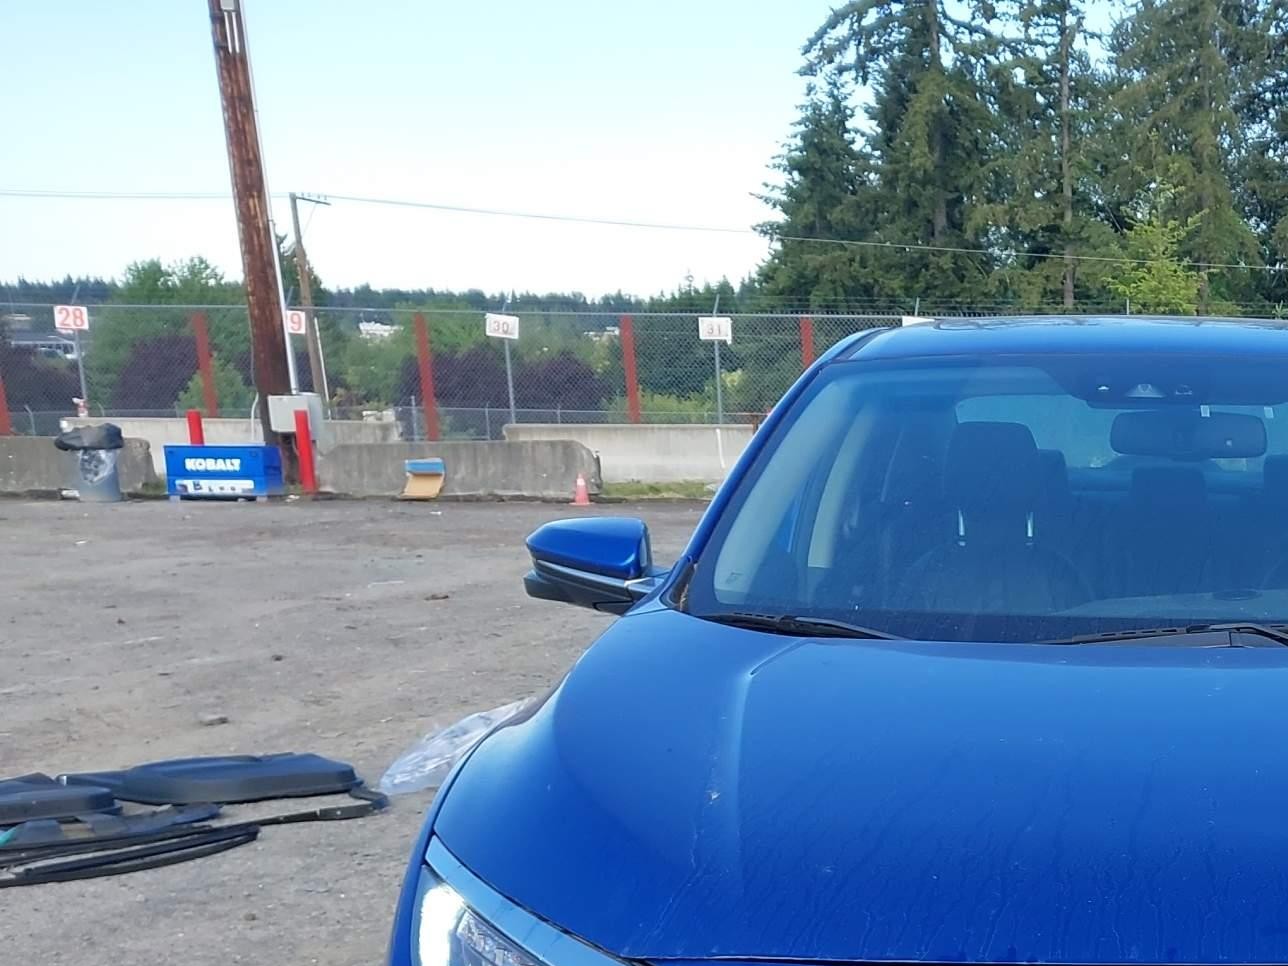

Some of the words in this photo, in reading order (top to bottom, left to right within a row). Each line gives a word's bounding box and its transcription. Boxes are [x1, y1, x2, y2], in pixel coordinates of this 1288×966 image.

[57, 307, 85, 327] 28
[287, 312, 302, 331] 9
[493, 320, 510, 335] 30
[706, 323, 721, 336] 31
[185, 458, 241, 472] KOBALT
